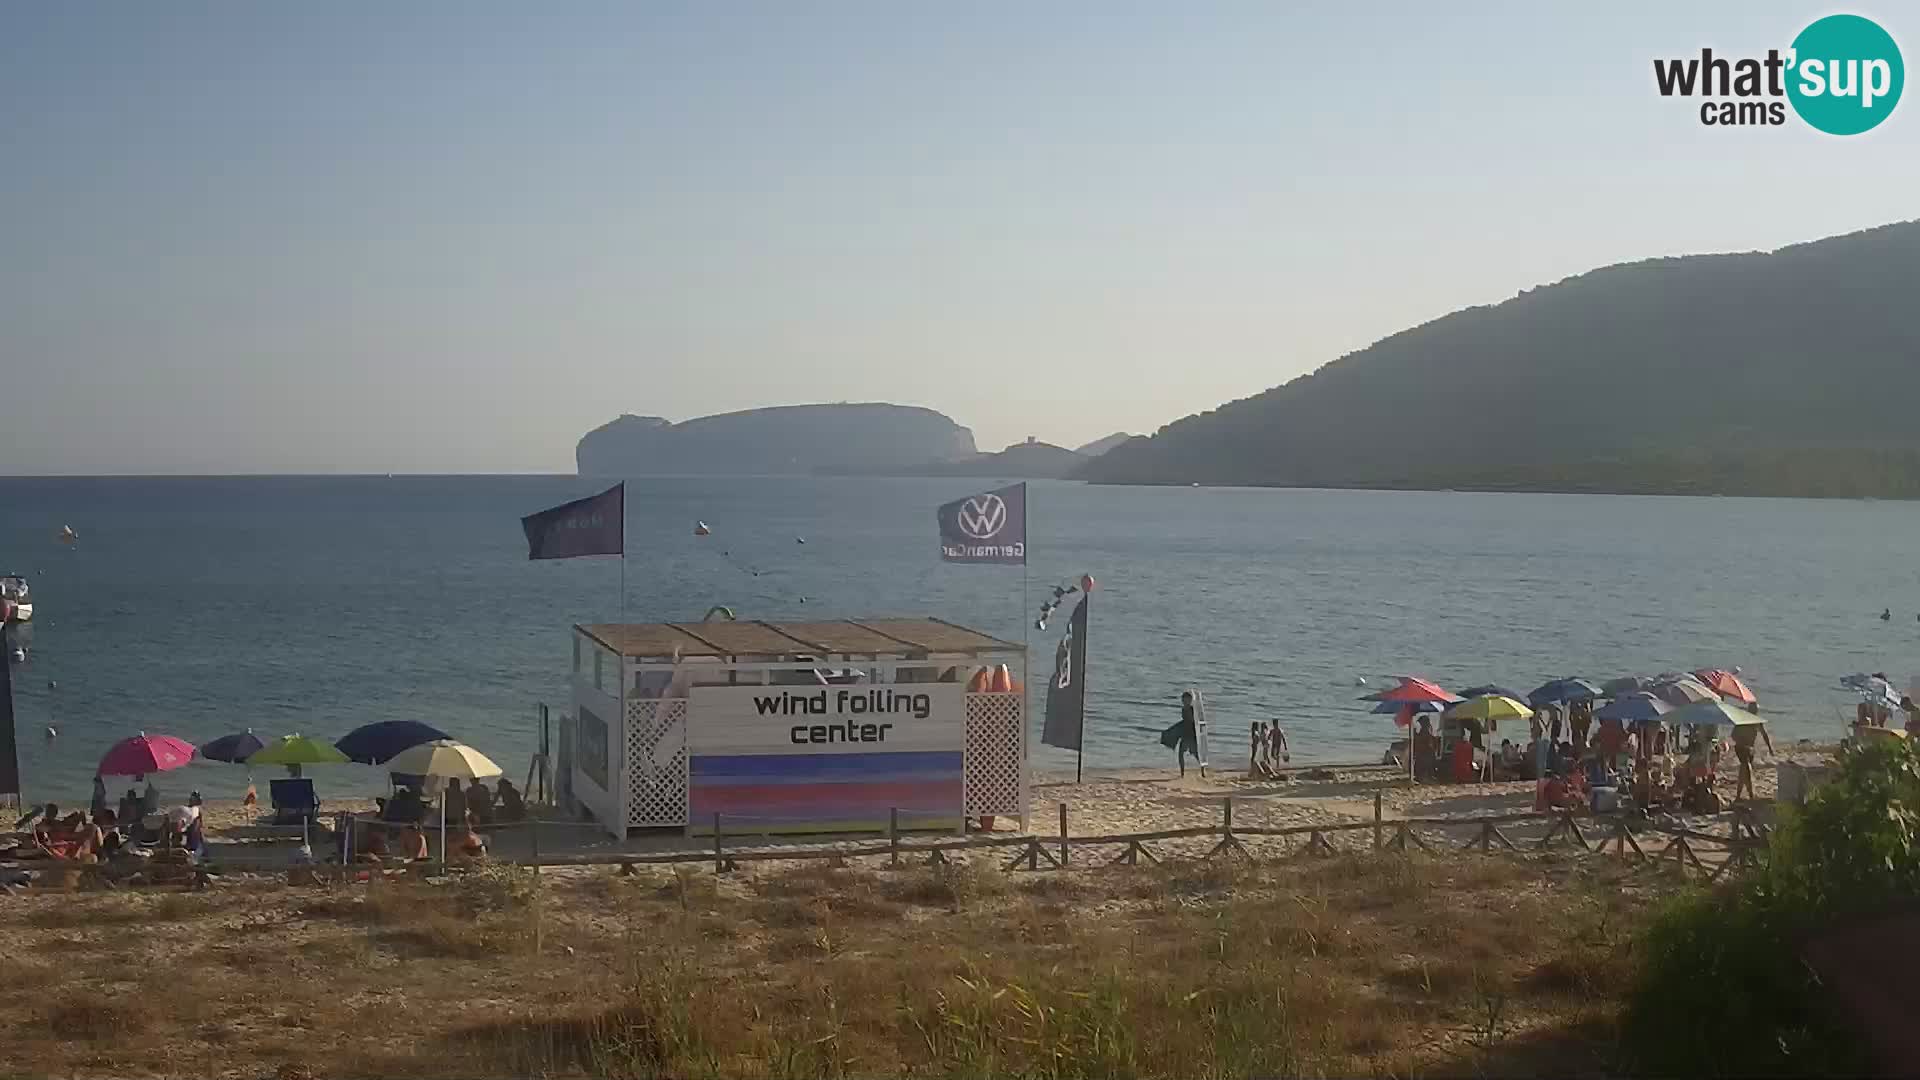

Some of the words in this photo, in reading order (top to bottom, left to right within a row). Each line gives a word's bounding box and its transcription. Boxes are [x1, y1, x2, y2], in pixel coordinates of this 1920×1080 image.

[753, 690, 827, 715] wind
[837, 689, 931, 719] foiling
[790, 720, 893, 744] center
